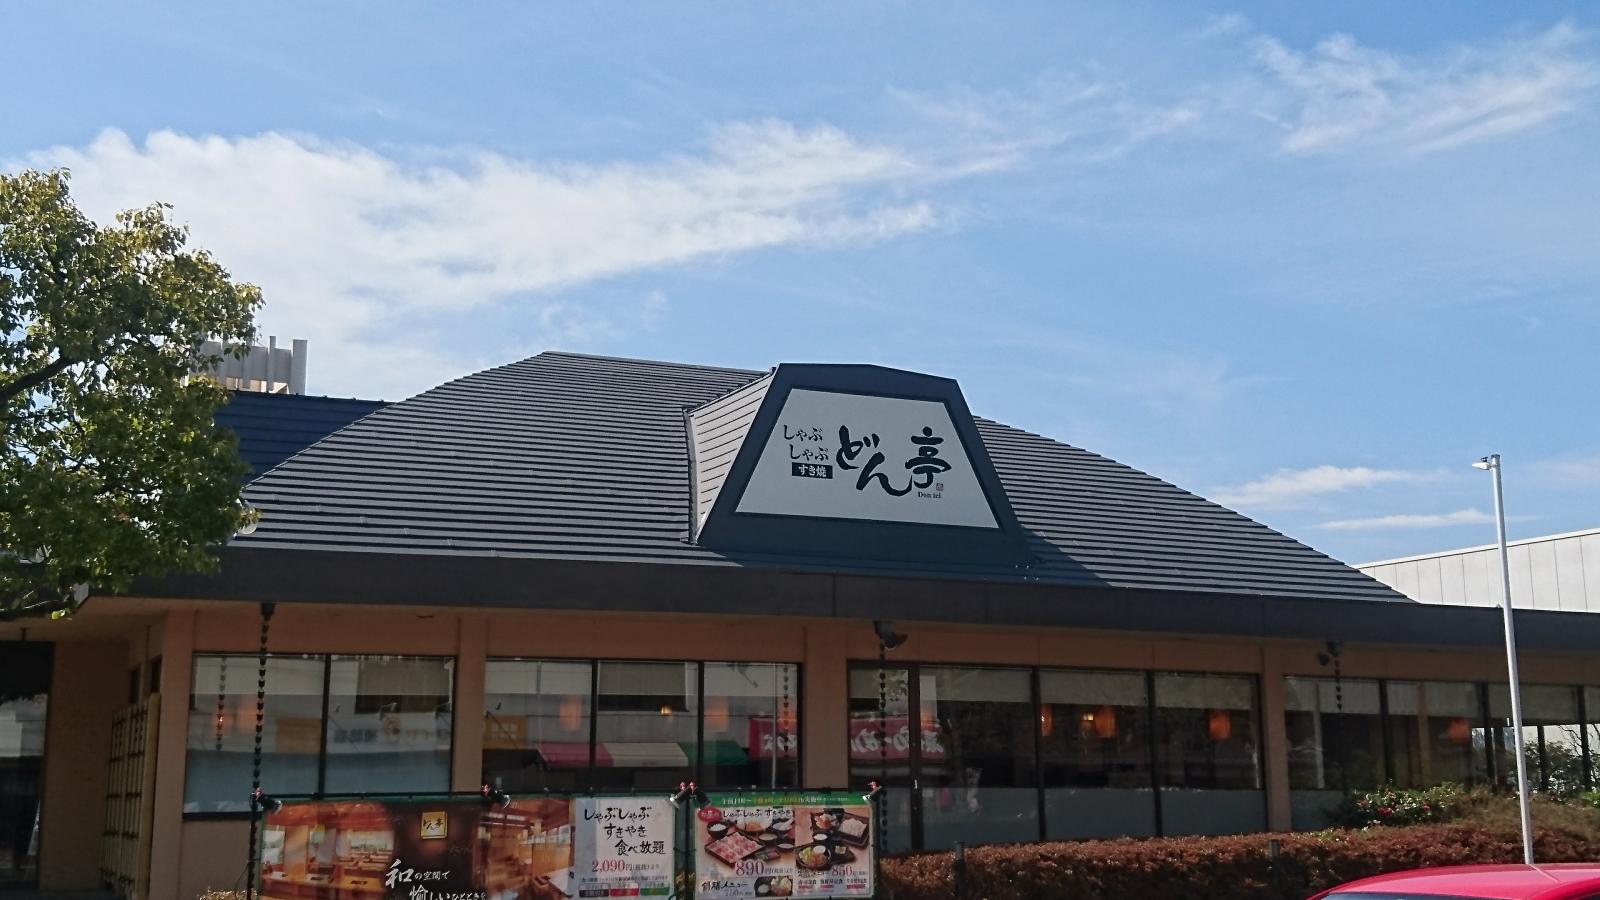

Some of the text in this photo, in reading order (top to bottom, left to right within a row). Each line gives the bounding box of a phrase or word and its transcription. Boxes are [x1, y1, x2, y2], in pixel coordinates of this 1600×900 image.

[783, 424, 823, 442] しゃぶ
[789, 444, 829, 462] しゃぶ
[836, 424, 952, 497] どん亭
[798, 464, 828, 478] すき焼
[584, 806, 652, 824] しゃぶしゃぶ
[604, 822, 648, 840] すきやき
[614, 838, 667, 857] 食べ放題
